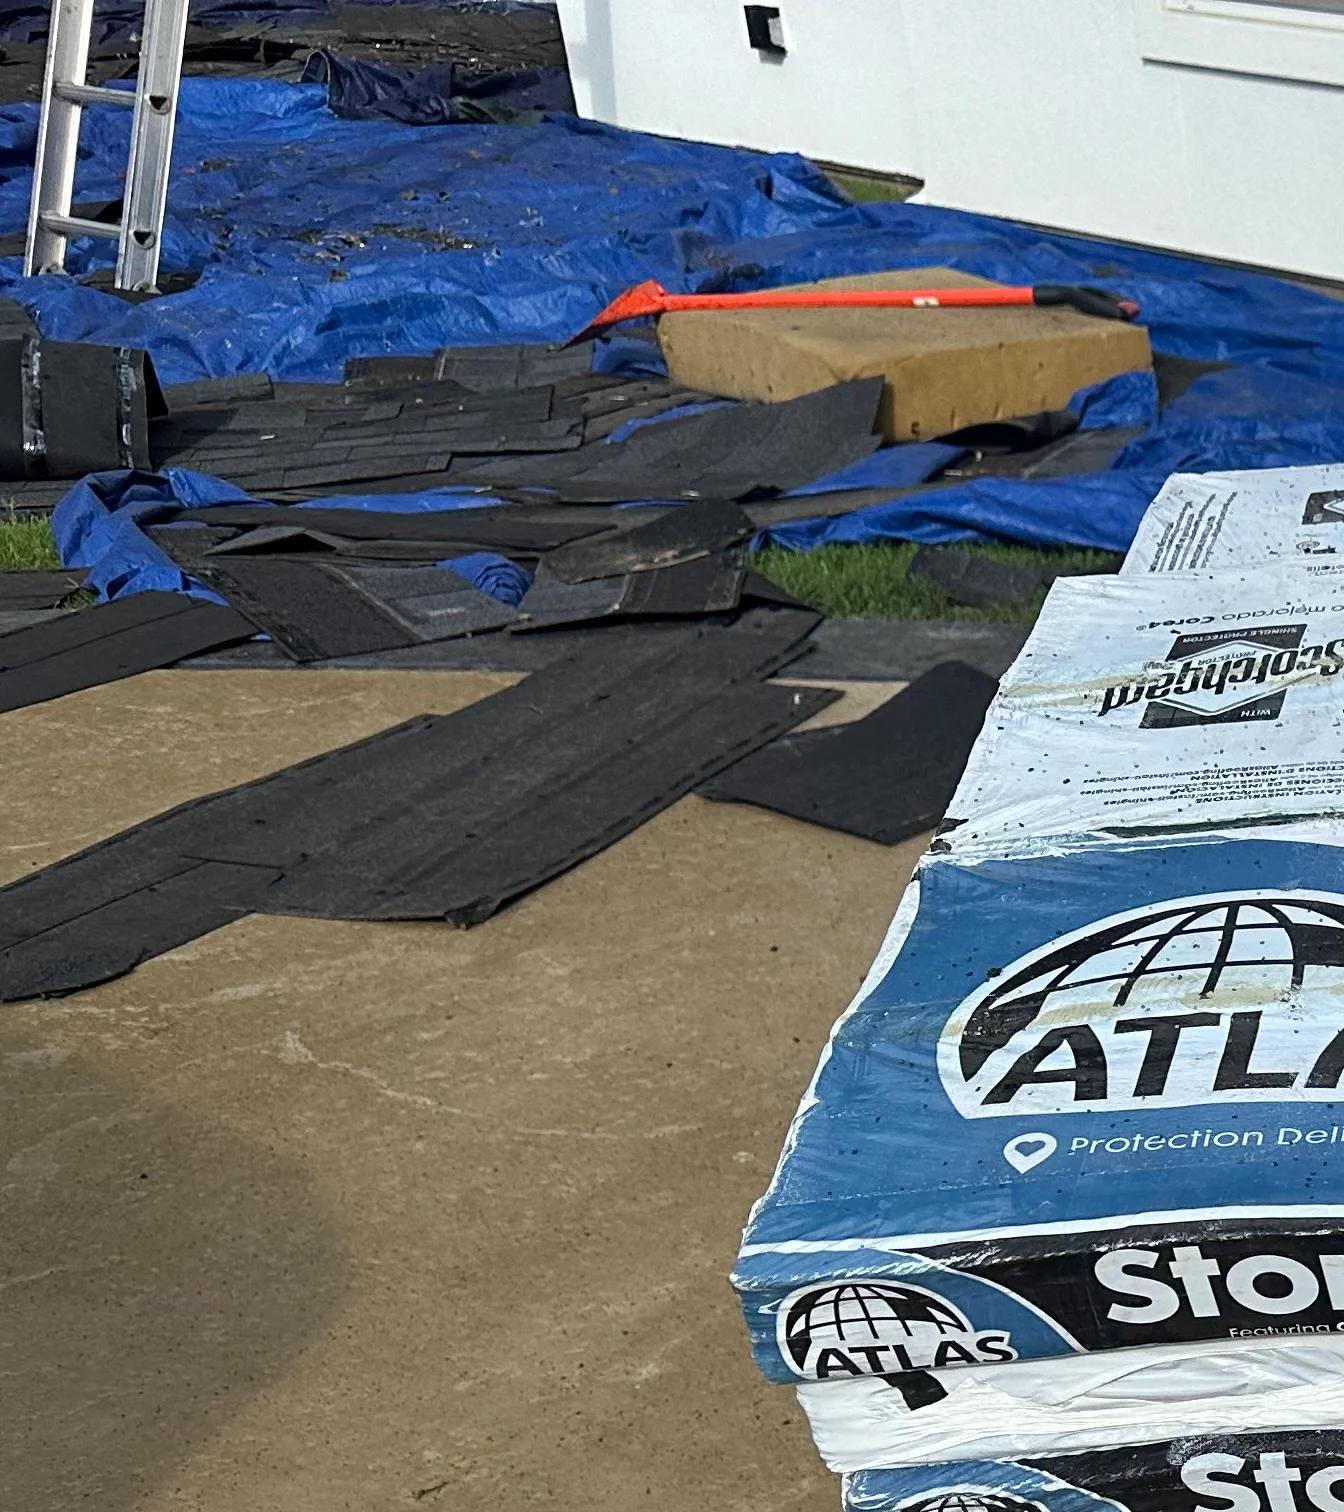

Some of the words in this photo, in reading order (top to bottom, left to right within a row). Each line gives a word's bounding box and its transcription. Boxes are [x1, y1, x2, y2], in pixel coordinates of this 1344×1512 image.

[1069, 1128, 1263, 1156] Protection
[1229, 1323, 1331, 1339] Featuring
[815, 1334, 1020, 1379] ATLAS
